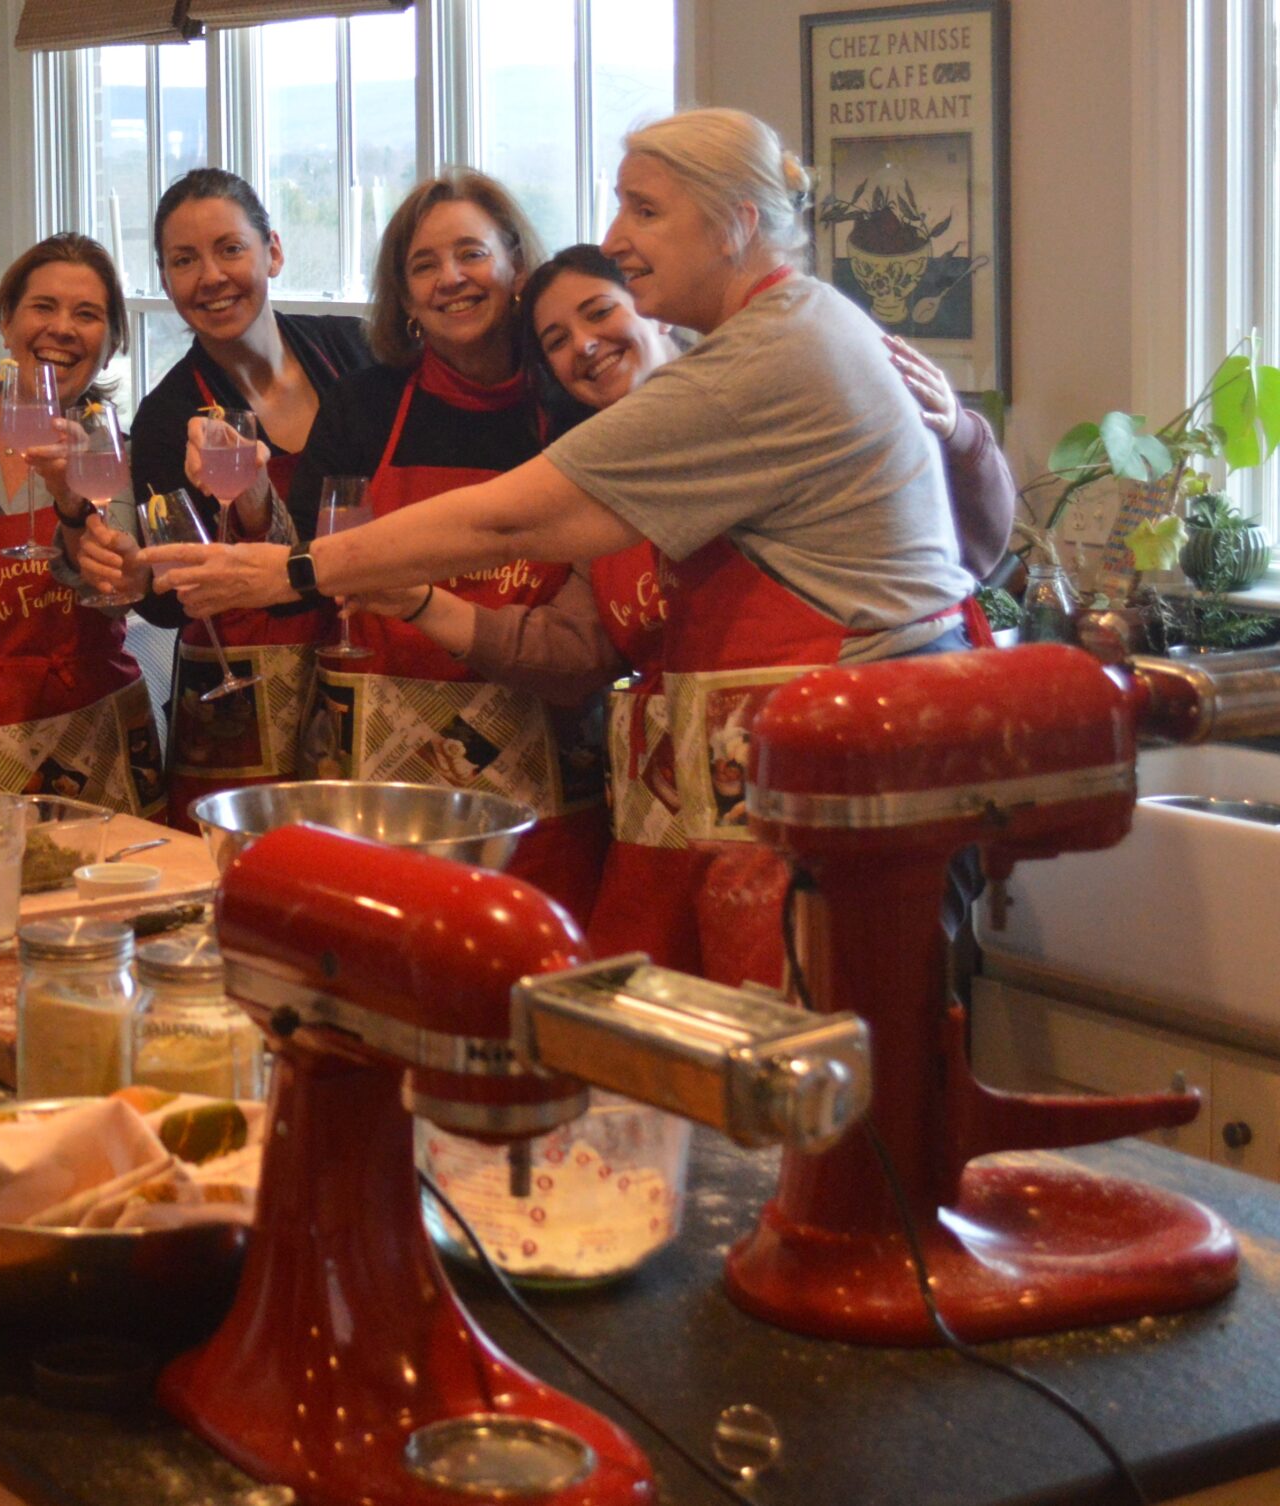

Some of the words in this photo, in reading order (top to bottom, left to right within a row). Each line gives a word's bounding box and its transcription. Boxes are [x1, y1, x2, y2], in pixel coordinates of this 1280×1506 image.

[828, 35, 880, 60] CHEZ
[887, 26, 970, 55] PANISSE
[869, 64, 928, 90] CAFE
[829, 95, 972, 125] RESTAURANT
